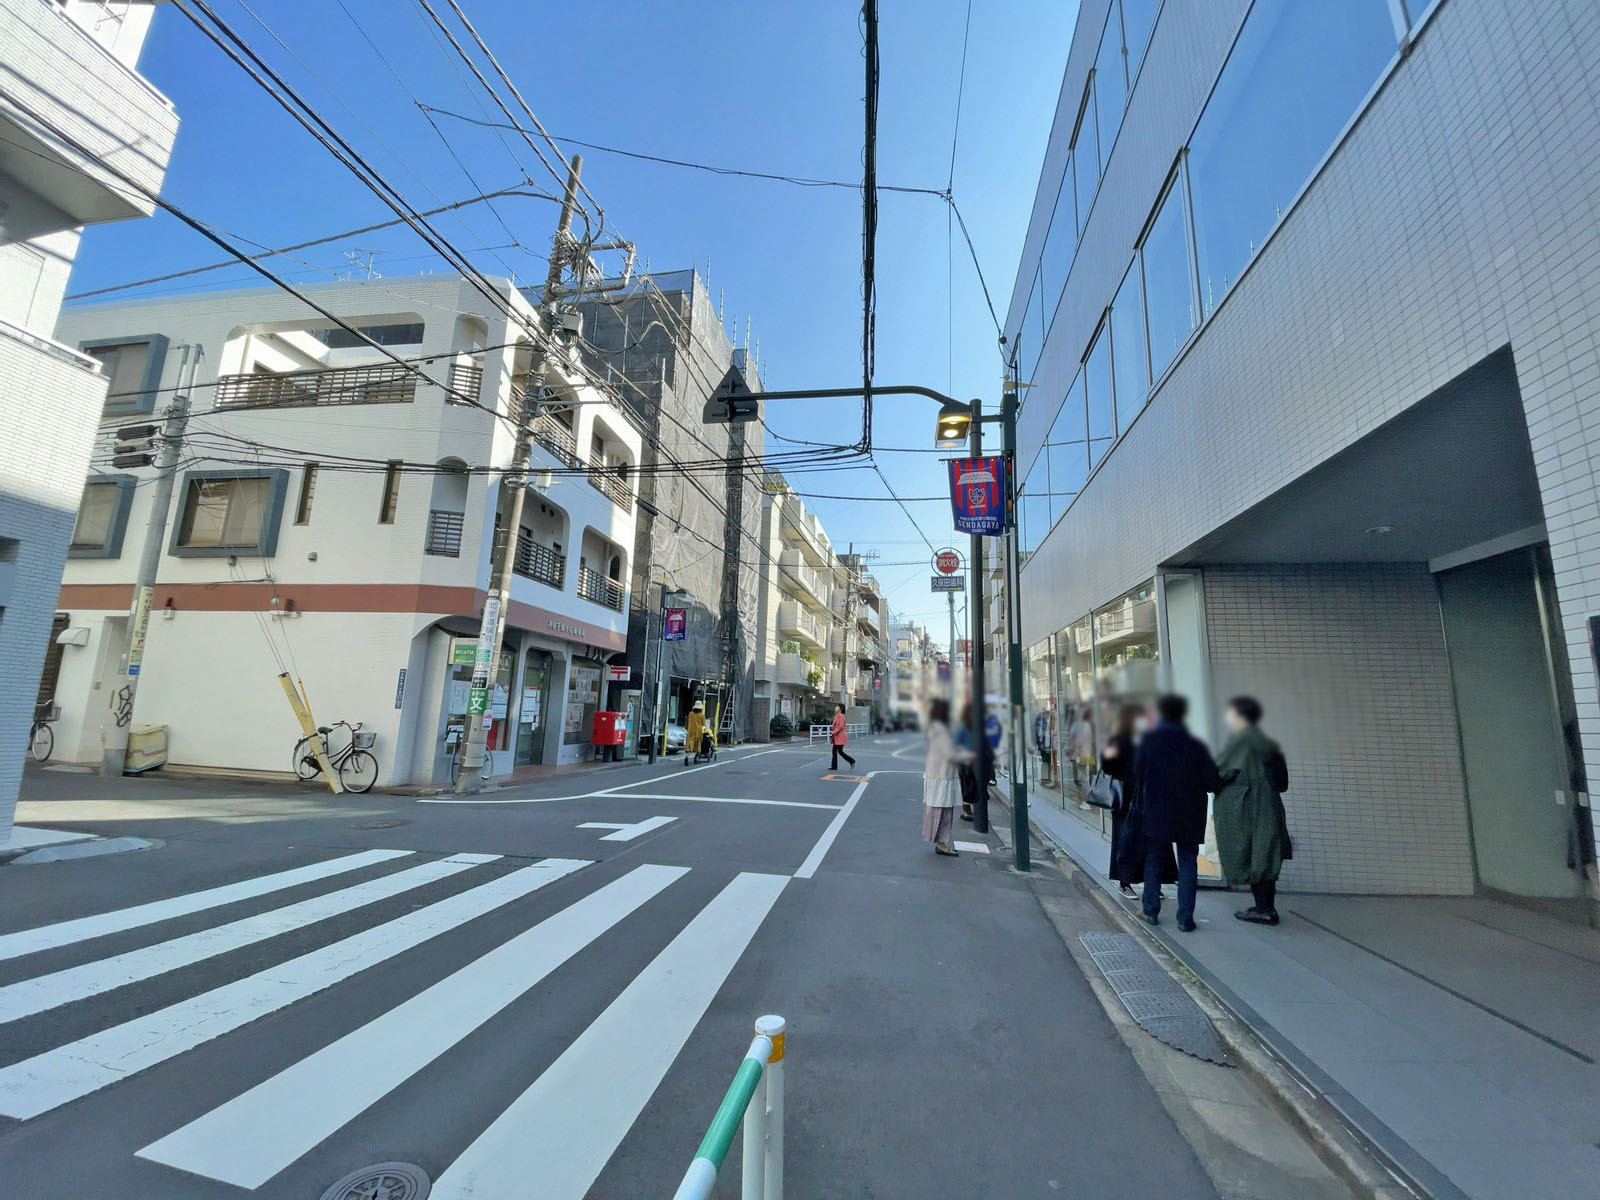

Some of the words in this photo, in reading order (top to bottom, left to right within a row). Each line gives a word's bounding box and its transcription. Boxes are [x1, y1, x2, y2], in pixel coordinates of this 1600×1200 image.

[958, 520, 999, 529] SENDAGAYA
[938, 558, 958, 567] 消火栓
[932, 578, 963, 587] 久保田歯科
[470, 697, 484, 710] 文
